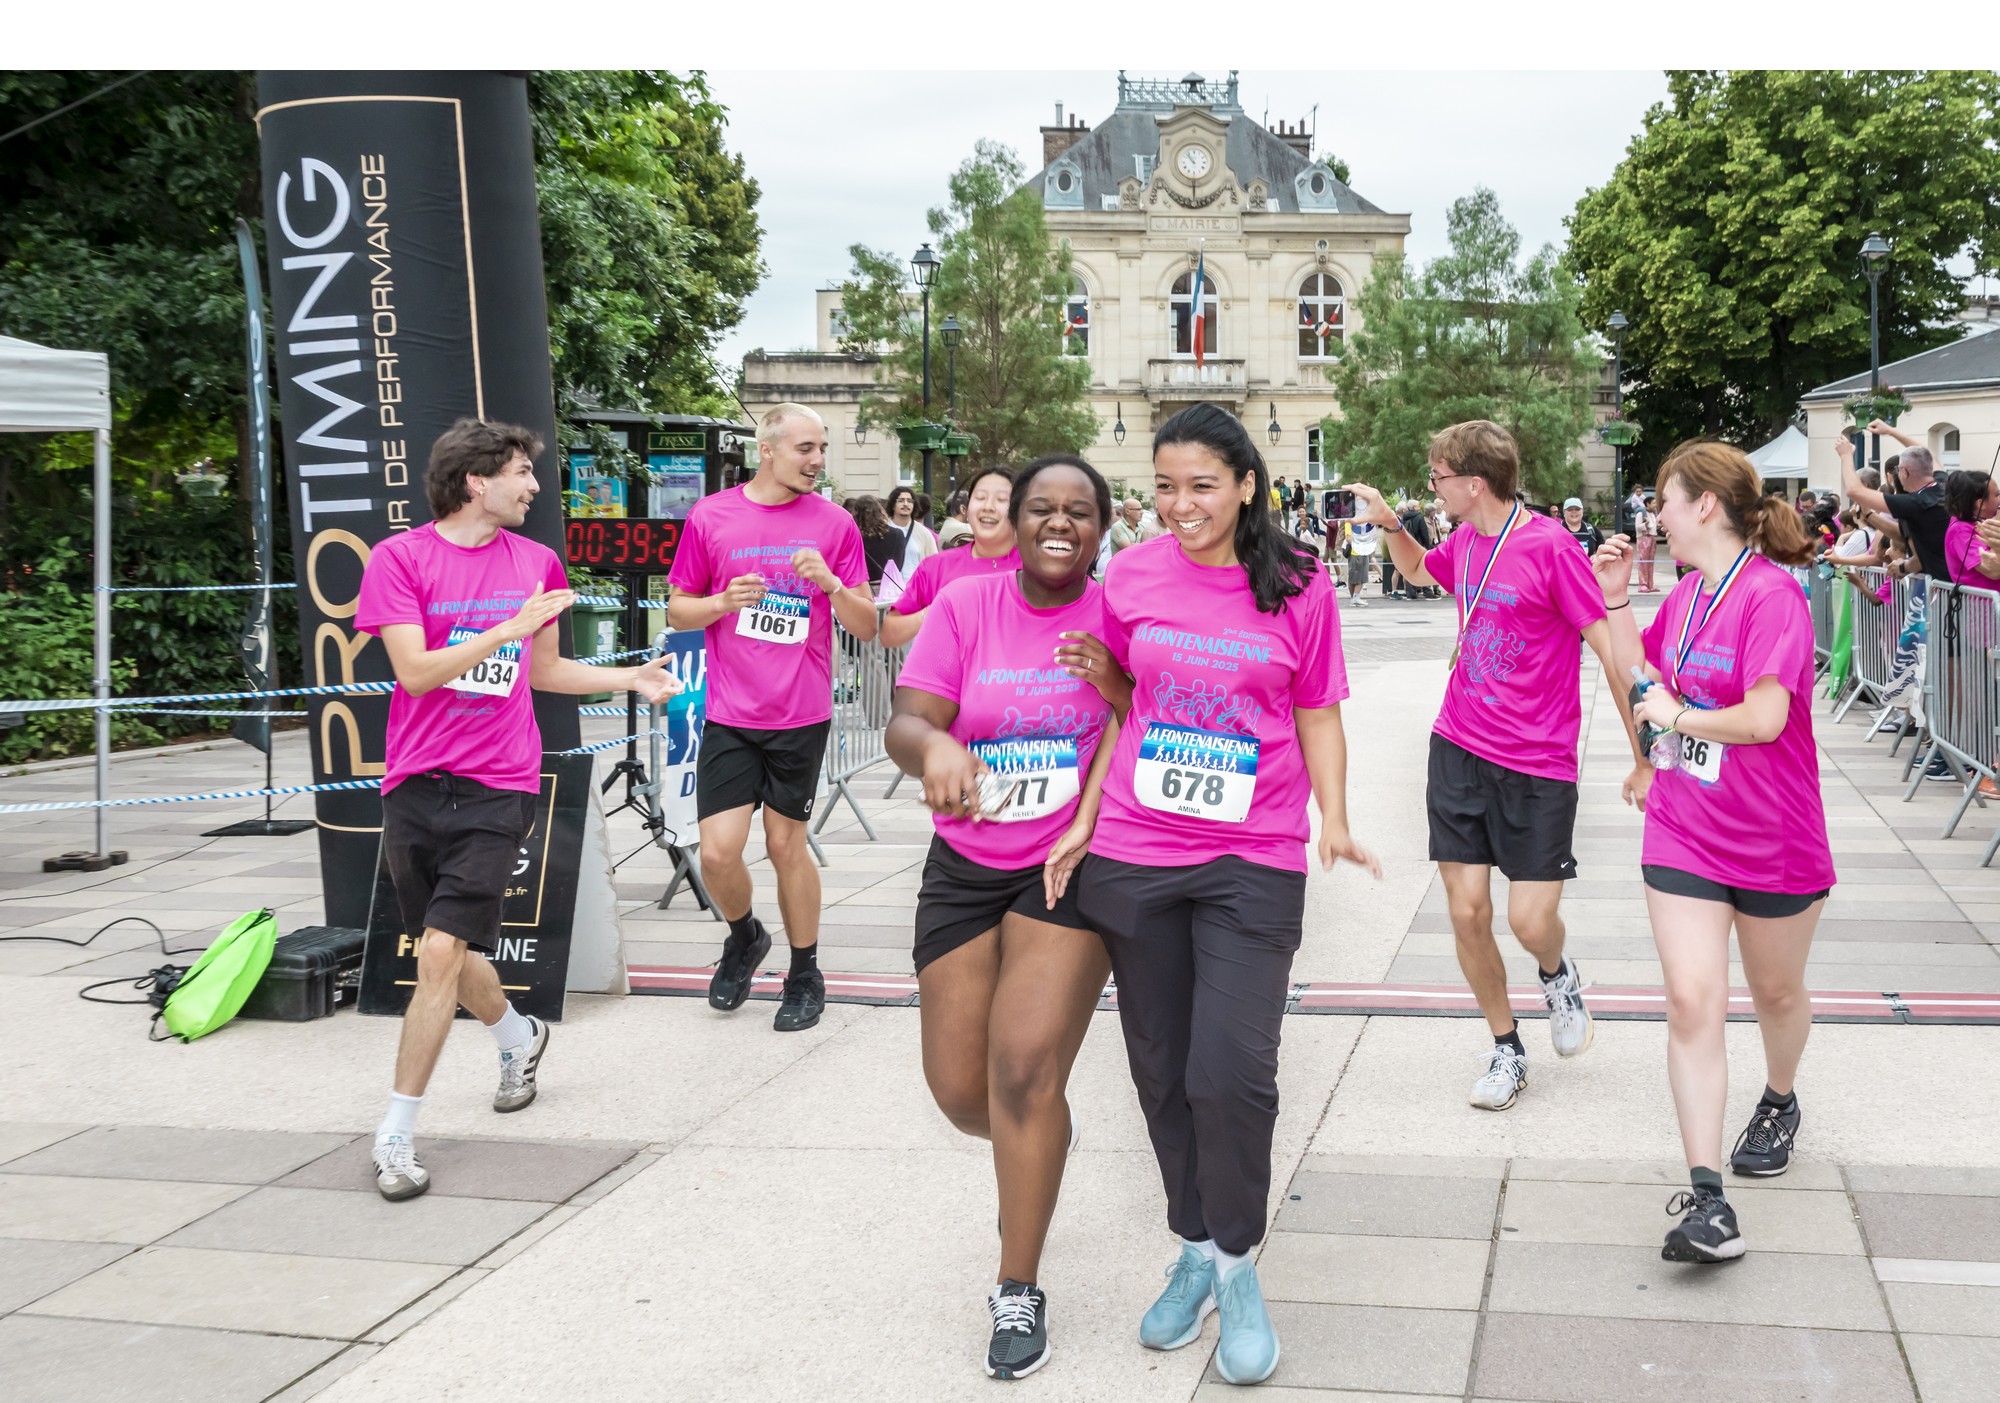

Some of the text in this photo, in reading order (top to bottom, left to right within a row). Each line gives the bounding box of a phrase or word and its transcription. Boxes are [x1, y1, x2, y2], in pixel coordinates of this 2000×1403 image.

[1168, 219, 1221, 229] MAIRIE
[360, 154, 404, 426] PERFORMANCE
[659, 435, 698, 449] PRESSE
[277, 157, 387, 776] PROTIMING
[383, 439, 409, 487] DE
[566, 522, 678, 564] 00:39:2
[750, 612, 797, 637] 1061
[1135, 624, 1273, 664] LA FONTENAISIENNE
[1171, 652, 1239, 673] 15 JUIN 2025
[1028, 686, 1052, 697] JUIN
[981, 738, 1074, 760] FONTENAISIENNE
[1145, 727, 1257, 757] LA FONTENAISIENNE
[1684, 736, 1709, 766] 36
[1006, 776, 1049, 807] 77
[1162, 768, 1225, 806] 678
[1177, 805, 1201, 815] AMINA
